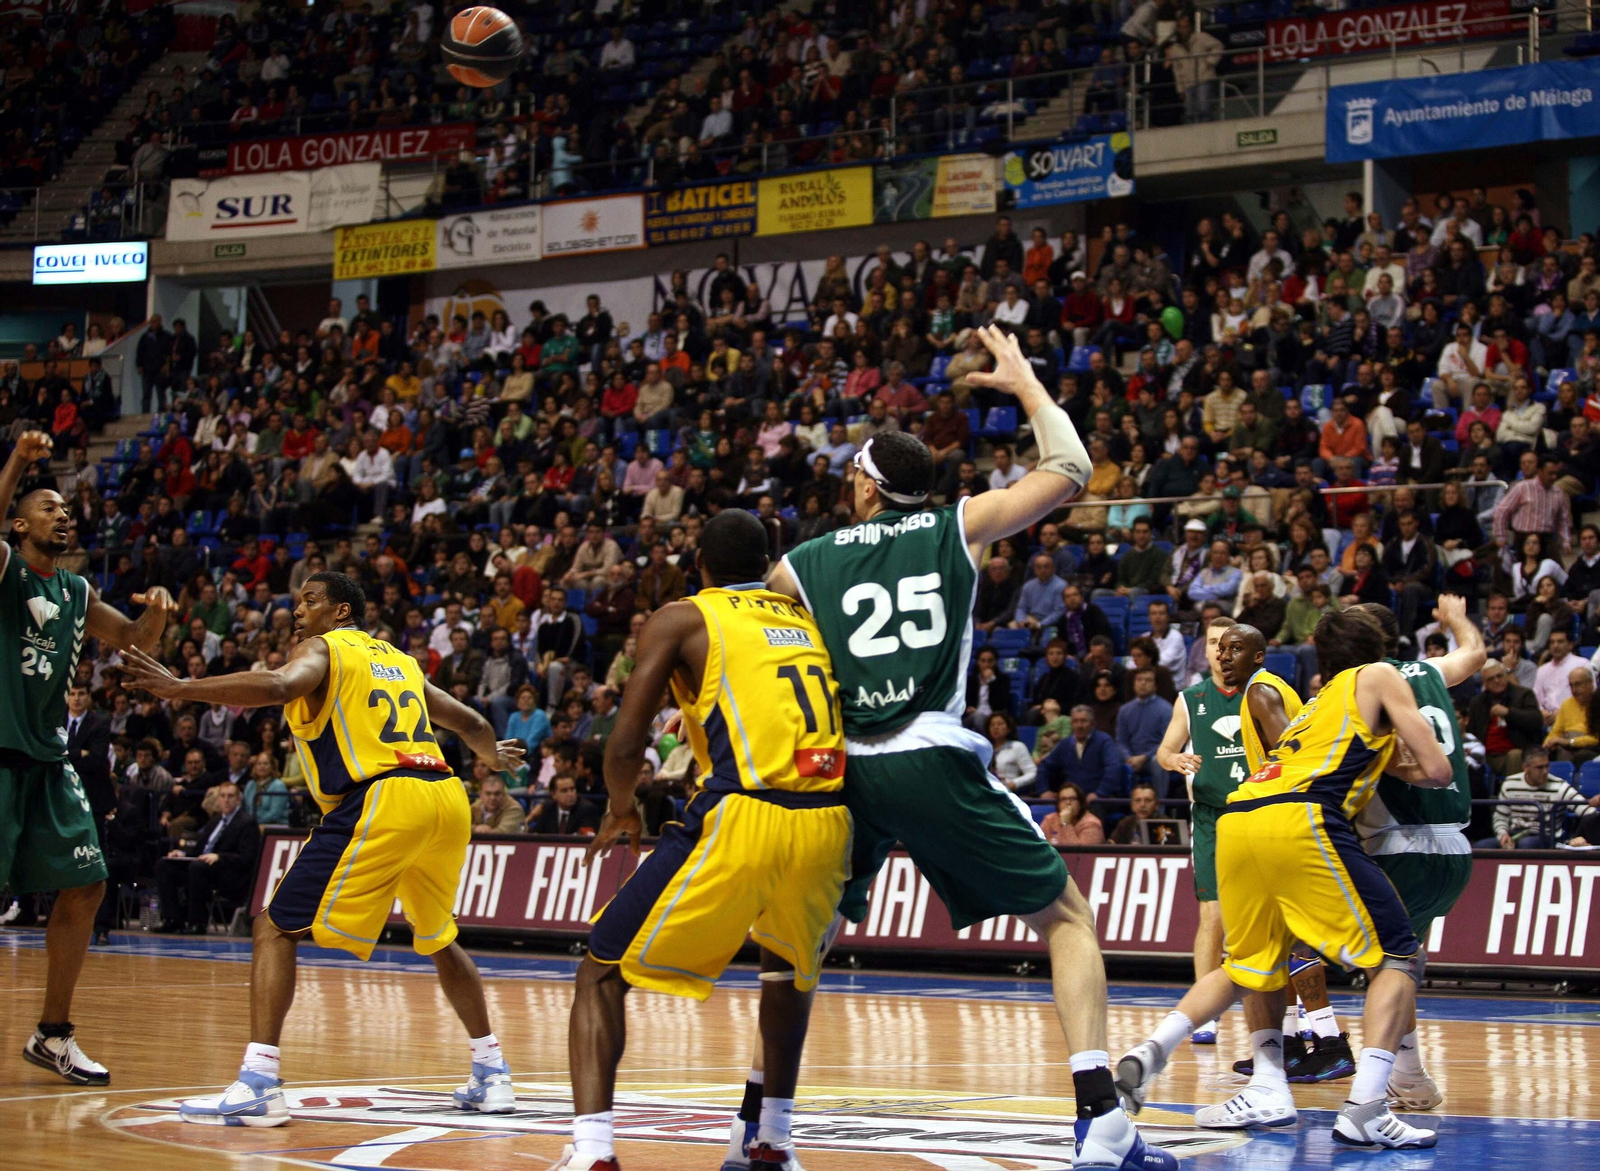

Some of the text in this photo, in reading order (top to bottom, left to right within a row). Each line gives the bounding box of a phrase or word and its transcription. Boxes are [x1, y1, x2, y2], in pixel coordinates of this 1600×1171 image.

[1269, 22, 1330, 57] LOLA
[1384, 87, 1593, 127] Ayuntamiento de Málaga
[233, 141, 293, 172] LOLA
[216, 193, 292, 220] SUR
[95, 251, 146, 266] IVECO
[341, 241, 430, 264] EXTINTORES
[841, 572, 947, 658] 25
[21, 646, 53, 681] 24
[368, 689, 436, 743] 22
[776, 664, 837, 736] 11
[1216, 744, 1246, 755] Unica
[1230, 761, 1246, 782] 4
[525, 846, 612, 922] FIAT
[1087, 857, 1189, 943] FIAT
[1486, 863, 1600, 957] FIAT
